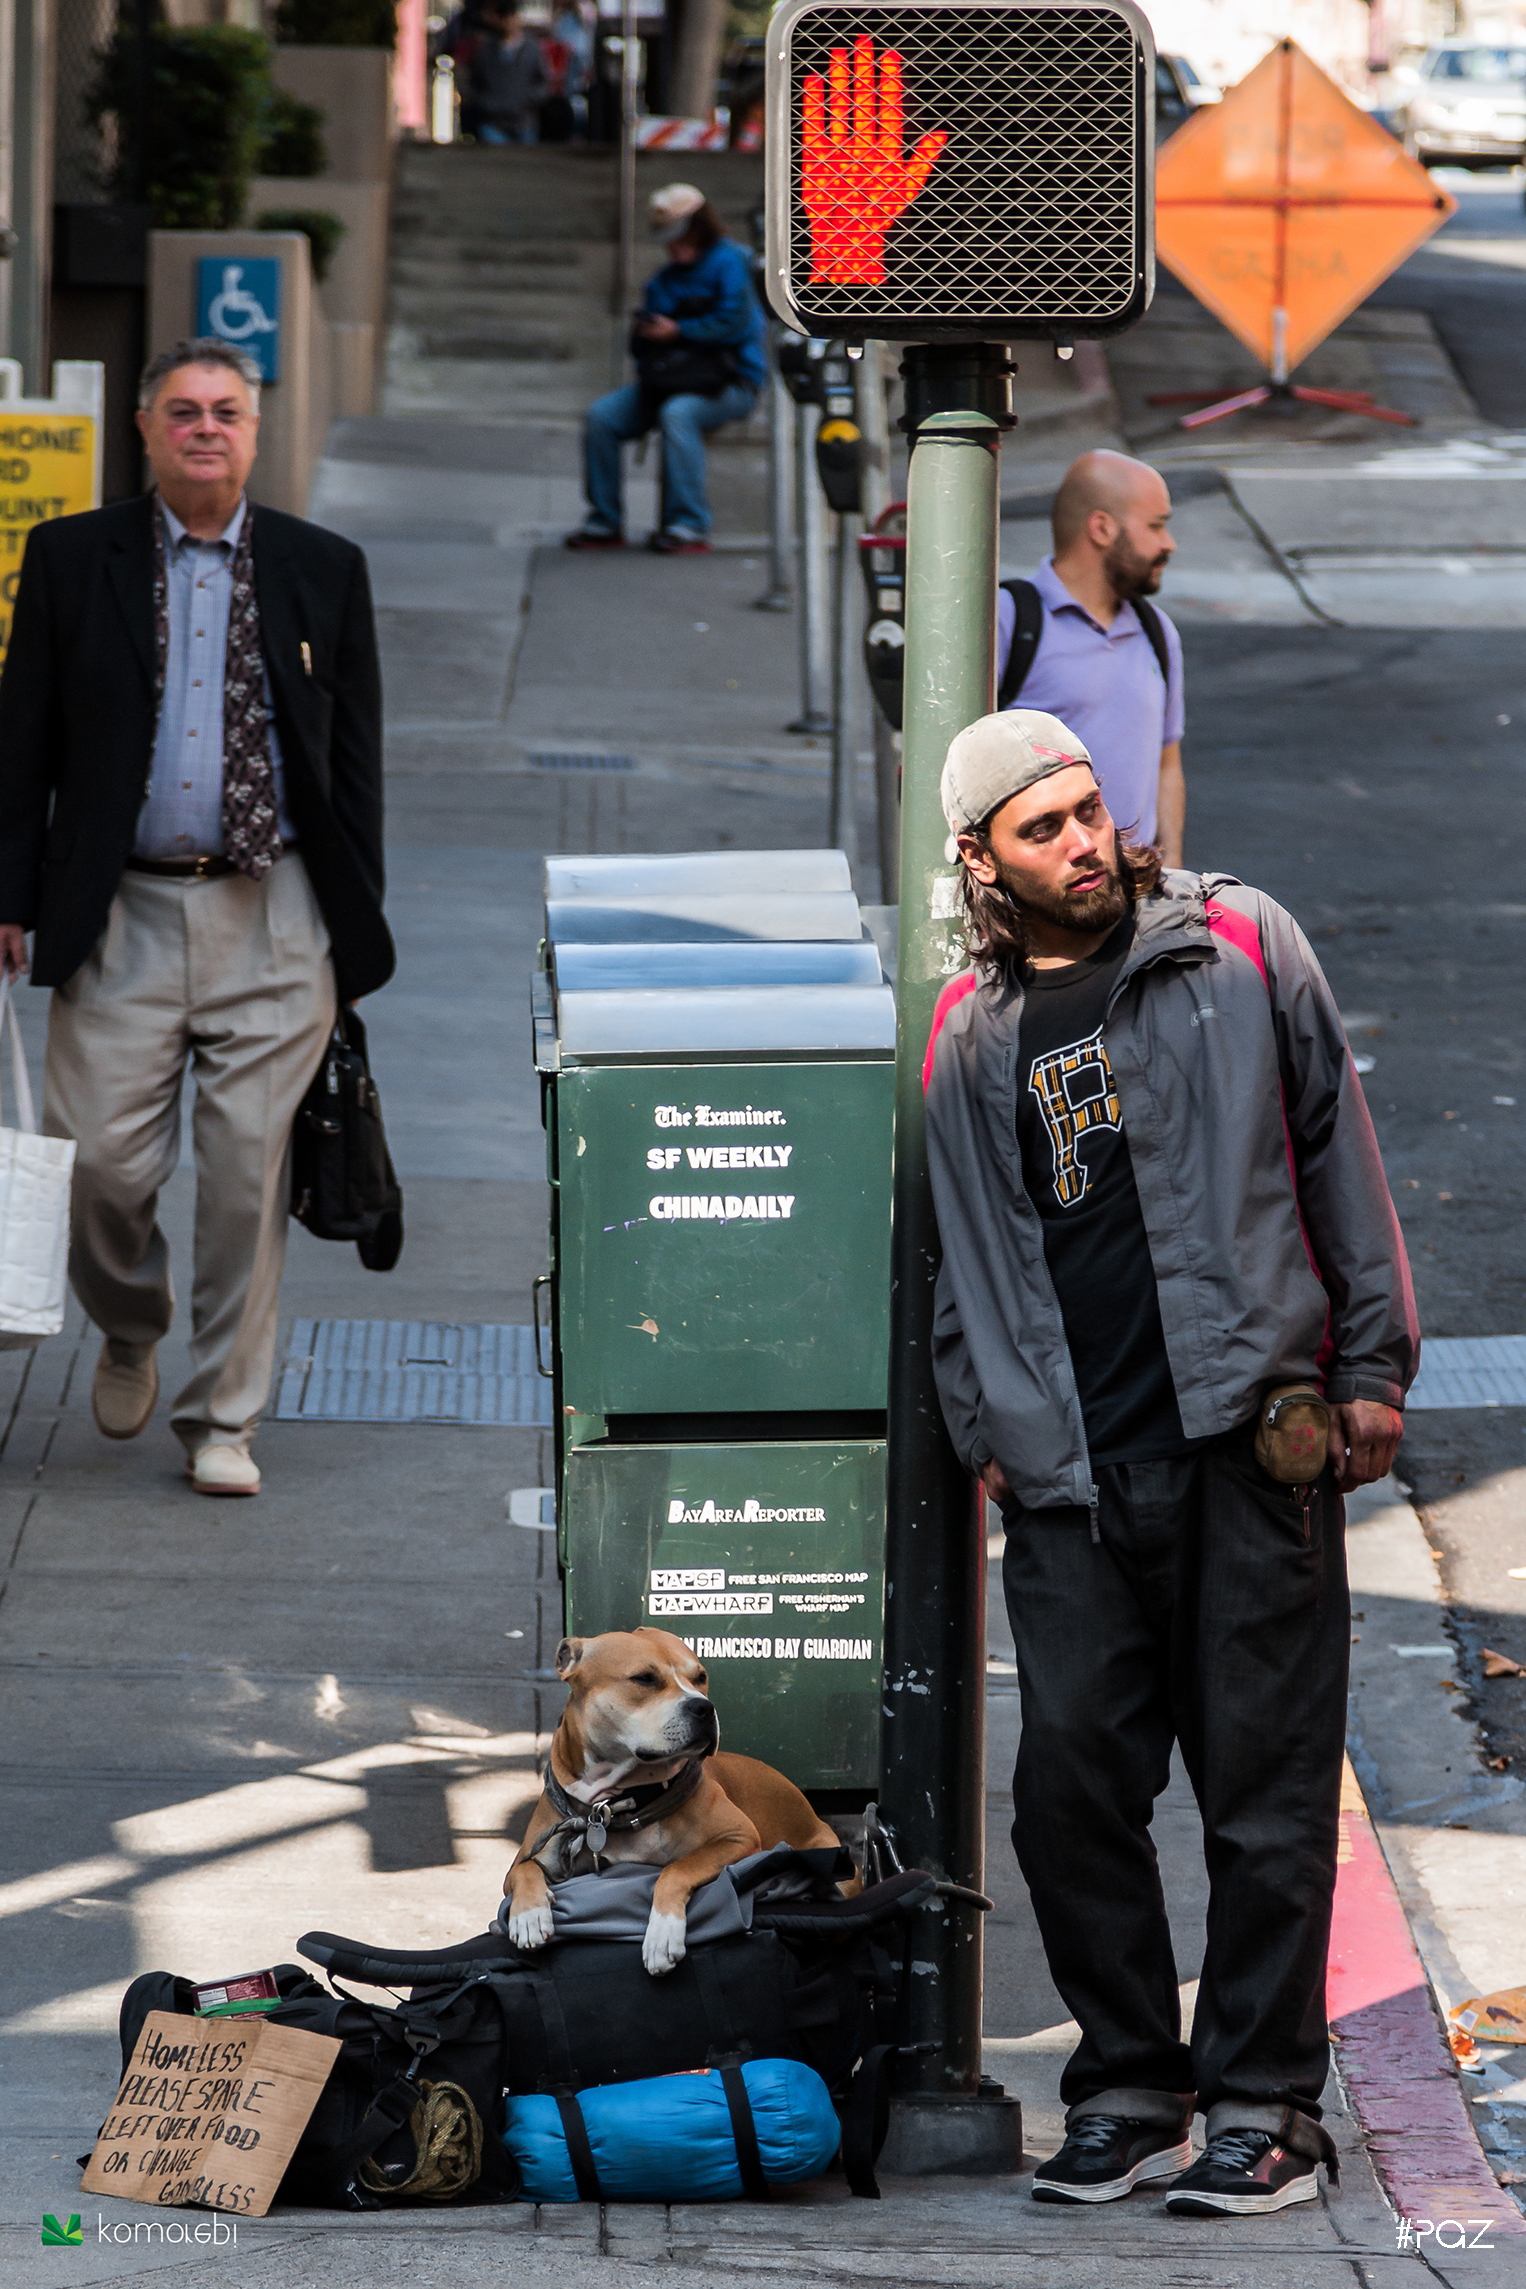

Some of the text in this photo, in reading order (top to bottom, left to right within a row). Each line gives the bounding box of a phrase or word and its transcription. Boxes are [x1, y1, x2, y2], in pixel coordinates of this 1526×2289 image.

[654, 1106, 692, 1128] The
[646, 1145, 793, 1170] SF WEEKLY
[649, 1195, 795, 1219] CHINADAILY
[728, 1576, 757, 1586] FREE
[758, 1575, 781, 1585] SAN
[782, 1573, 844, 1585] FRANCISCO
[845, 1573, 869, 1584] MAP
[778, 1594, 865, 1604] FREE FISHERMAN'S
[795, 1603, 850, 1613] WHARF MAP
[697, 1637, 772, 1658] FRANCISCO
[774, 1637, 801, 1659] BAY
[803, 1638, 872, 1660] GUARDIAN
[140, 2029, 247, 2073] HOMELESS
[156, 2115, 202, 2142] OVER
[201, 2114, 261, 2151] FOOD
[138, 2148, 203, 2177] CHANGE
